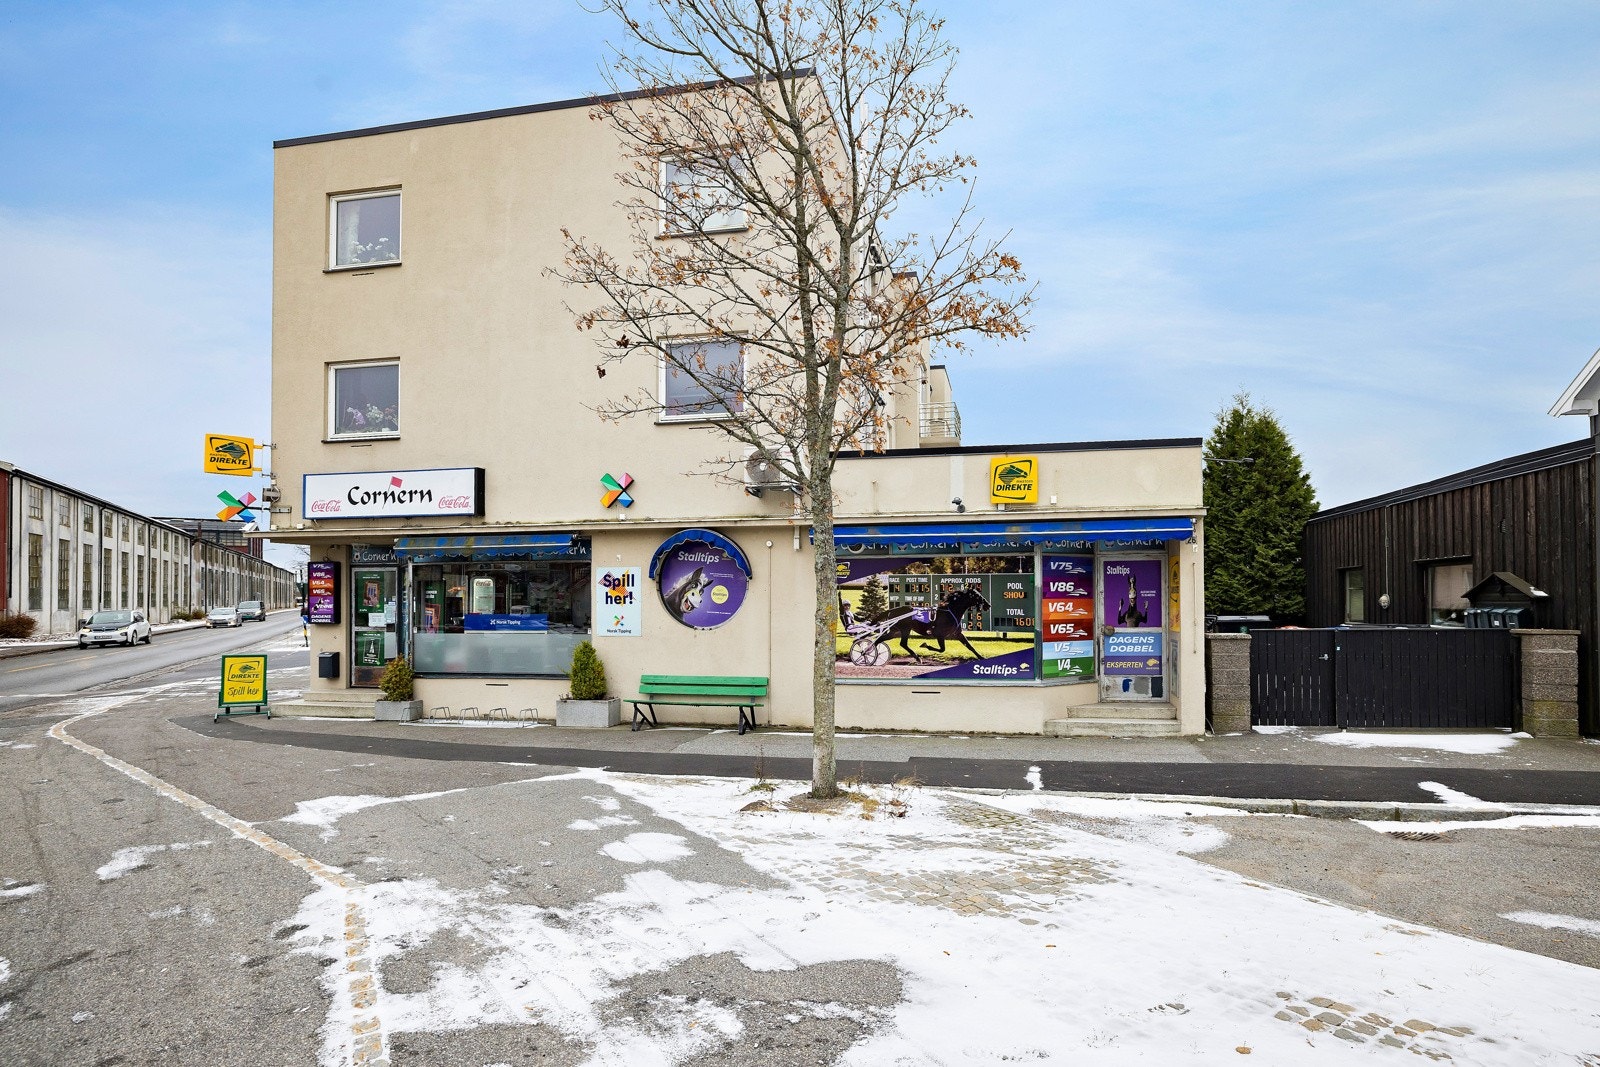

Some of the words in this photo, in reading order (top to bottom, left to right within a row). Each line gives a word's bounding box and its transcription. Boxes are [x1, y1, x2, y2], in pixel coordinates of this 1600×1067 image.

[210, 456, 248, 466] DIREKTE
[347, 486, 433, 506] Cornern
[678, 550, 720, 564] Stalltips
[1050, 562, 1073, 570] V75
[1106, 565, 1130, 576] Stalltips
[603, 574, 634, 590] Spill
[1007, 582, 1023, 590] POOL
[1050, 582, 1075, 592] V86
[605, 591, 633, 604] her!
[1003, 591, 1024, 599] SHOW
[1048, 602, 1074, 612] V64
[1050, 624, 1074, 634] V65
[1109, 636, 1155, 644] DAGENS
[1054, 642, 1071, 652] V5
[1110, 645, 1154, 653] DOBBEL
[1057, 659, 1071, 670] V4
[972, 664, 1018, 676] Stalltips
[228, 686, 246, 697] Spill
[247, 686, 260, 695] her
